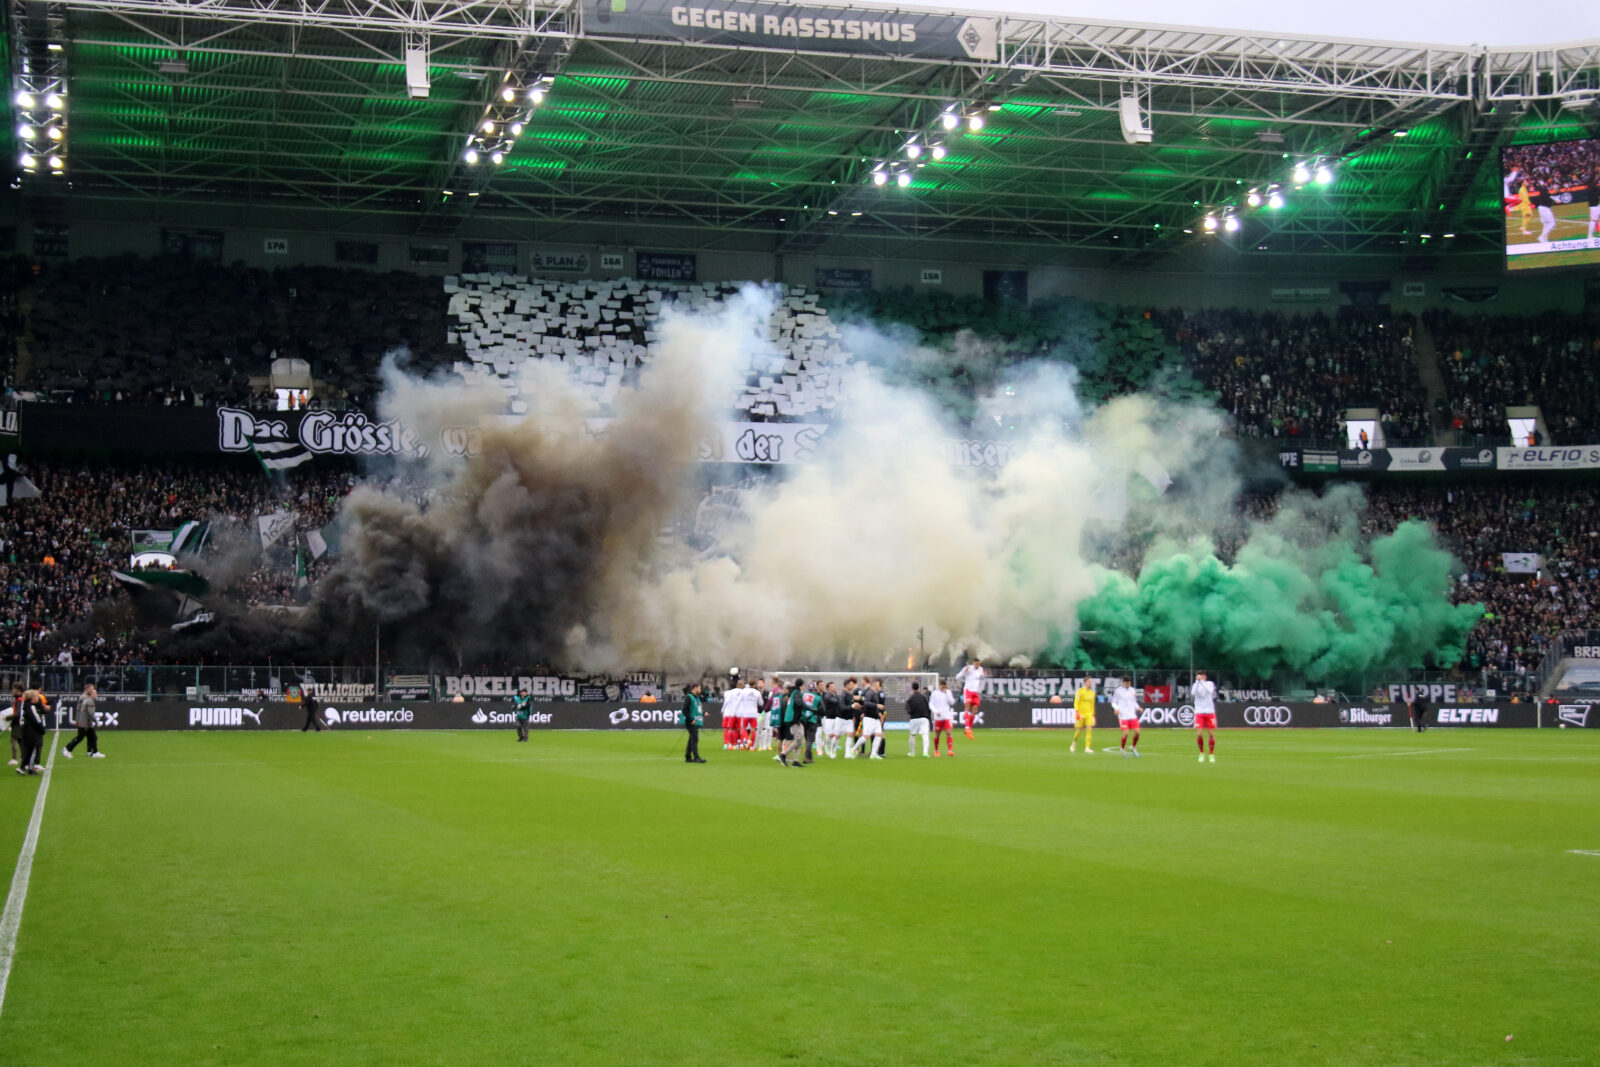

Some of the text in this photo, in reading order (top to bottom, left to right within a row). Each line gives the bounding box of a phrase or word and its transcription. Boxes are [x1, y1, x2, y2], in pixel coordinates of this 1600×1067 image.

[671, 6, 917, 43] GEGEN RASSISMUS
[546, 256, 574, 267] PLAN
[440, 426, 483, 458] wa
[736, 428, 784, 462] der
[1278, 452, 1298, 467] PE
[1589, 450, 1600, 463] S
[300, 683, 375, 697] WILLICHER
[447, 674, 575, 696] BÖKELBERG
[55, 707, 119, 727] flex
[190, 707, 242, 726] PUMA
[342, 707, 414, 723] reuter.de
[489, 711, 553, 723] Santder
[631, 709, 683, 724] sonep
[1138, 707, 1177, 724] AOK
[1350, 707, 1392, 725] Bitburger
[1437, 708, 1499, 723] ELTEN
